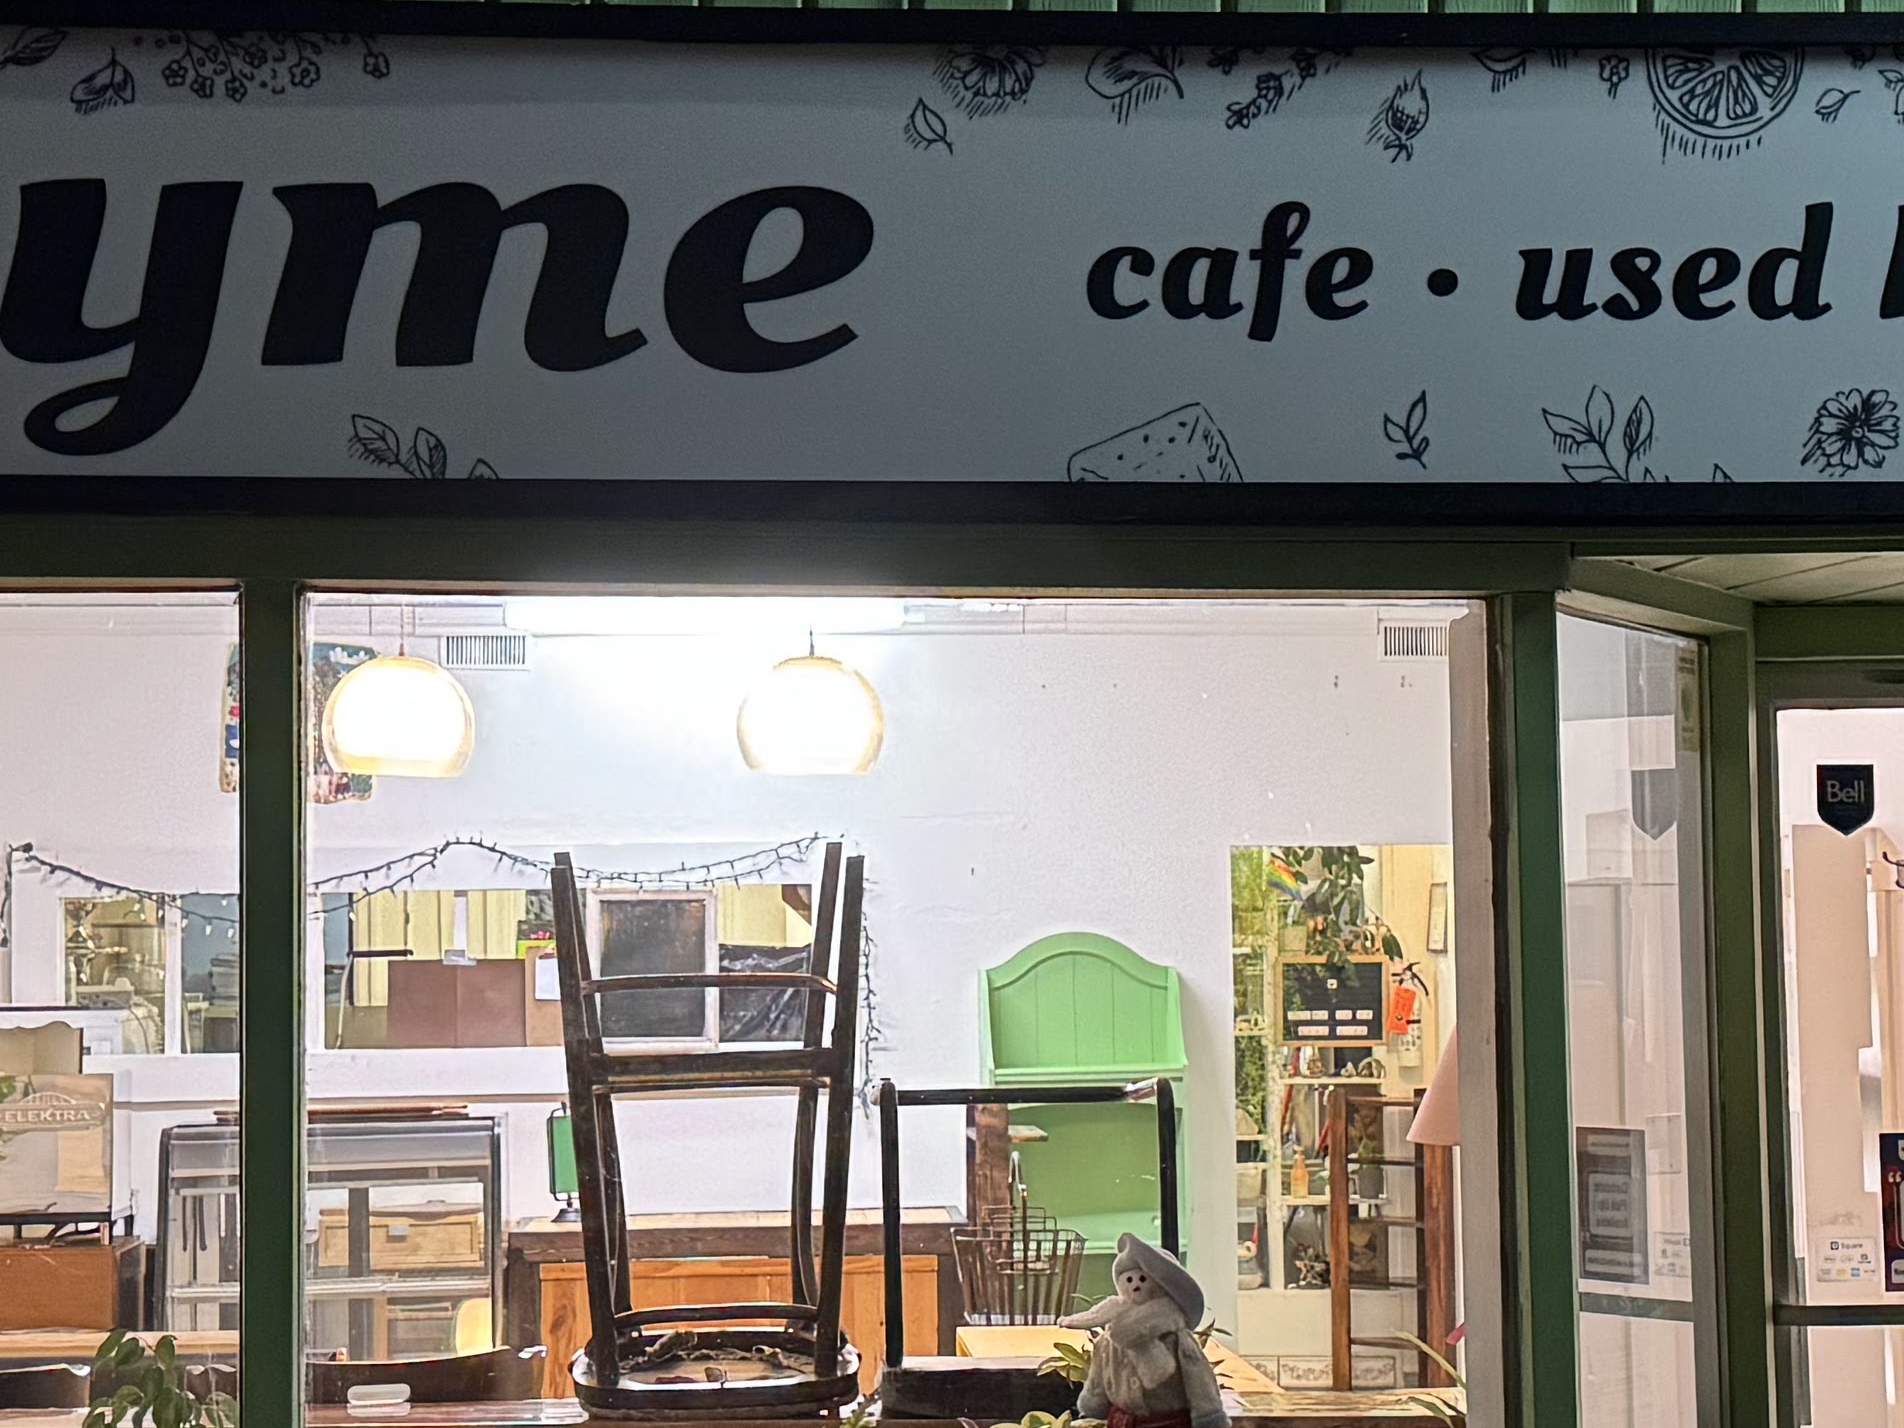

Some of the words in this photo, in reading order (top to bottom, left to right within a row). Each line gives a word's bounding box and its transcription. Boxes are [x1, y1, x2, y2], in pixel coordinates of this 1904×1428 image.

[1086, 200, 1374, 343] cafe
[1515, 201, 1834, 321] used
[1827, 780, 1865, 803] Bell
[4, 1107, 91, 1123] ELEKTRA
